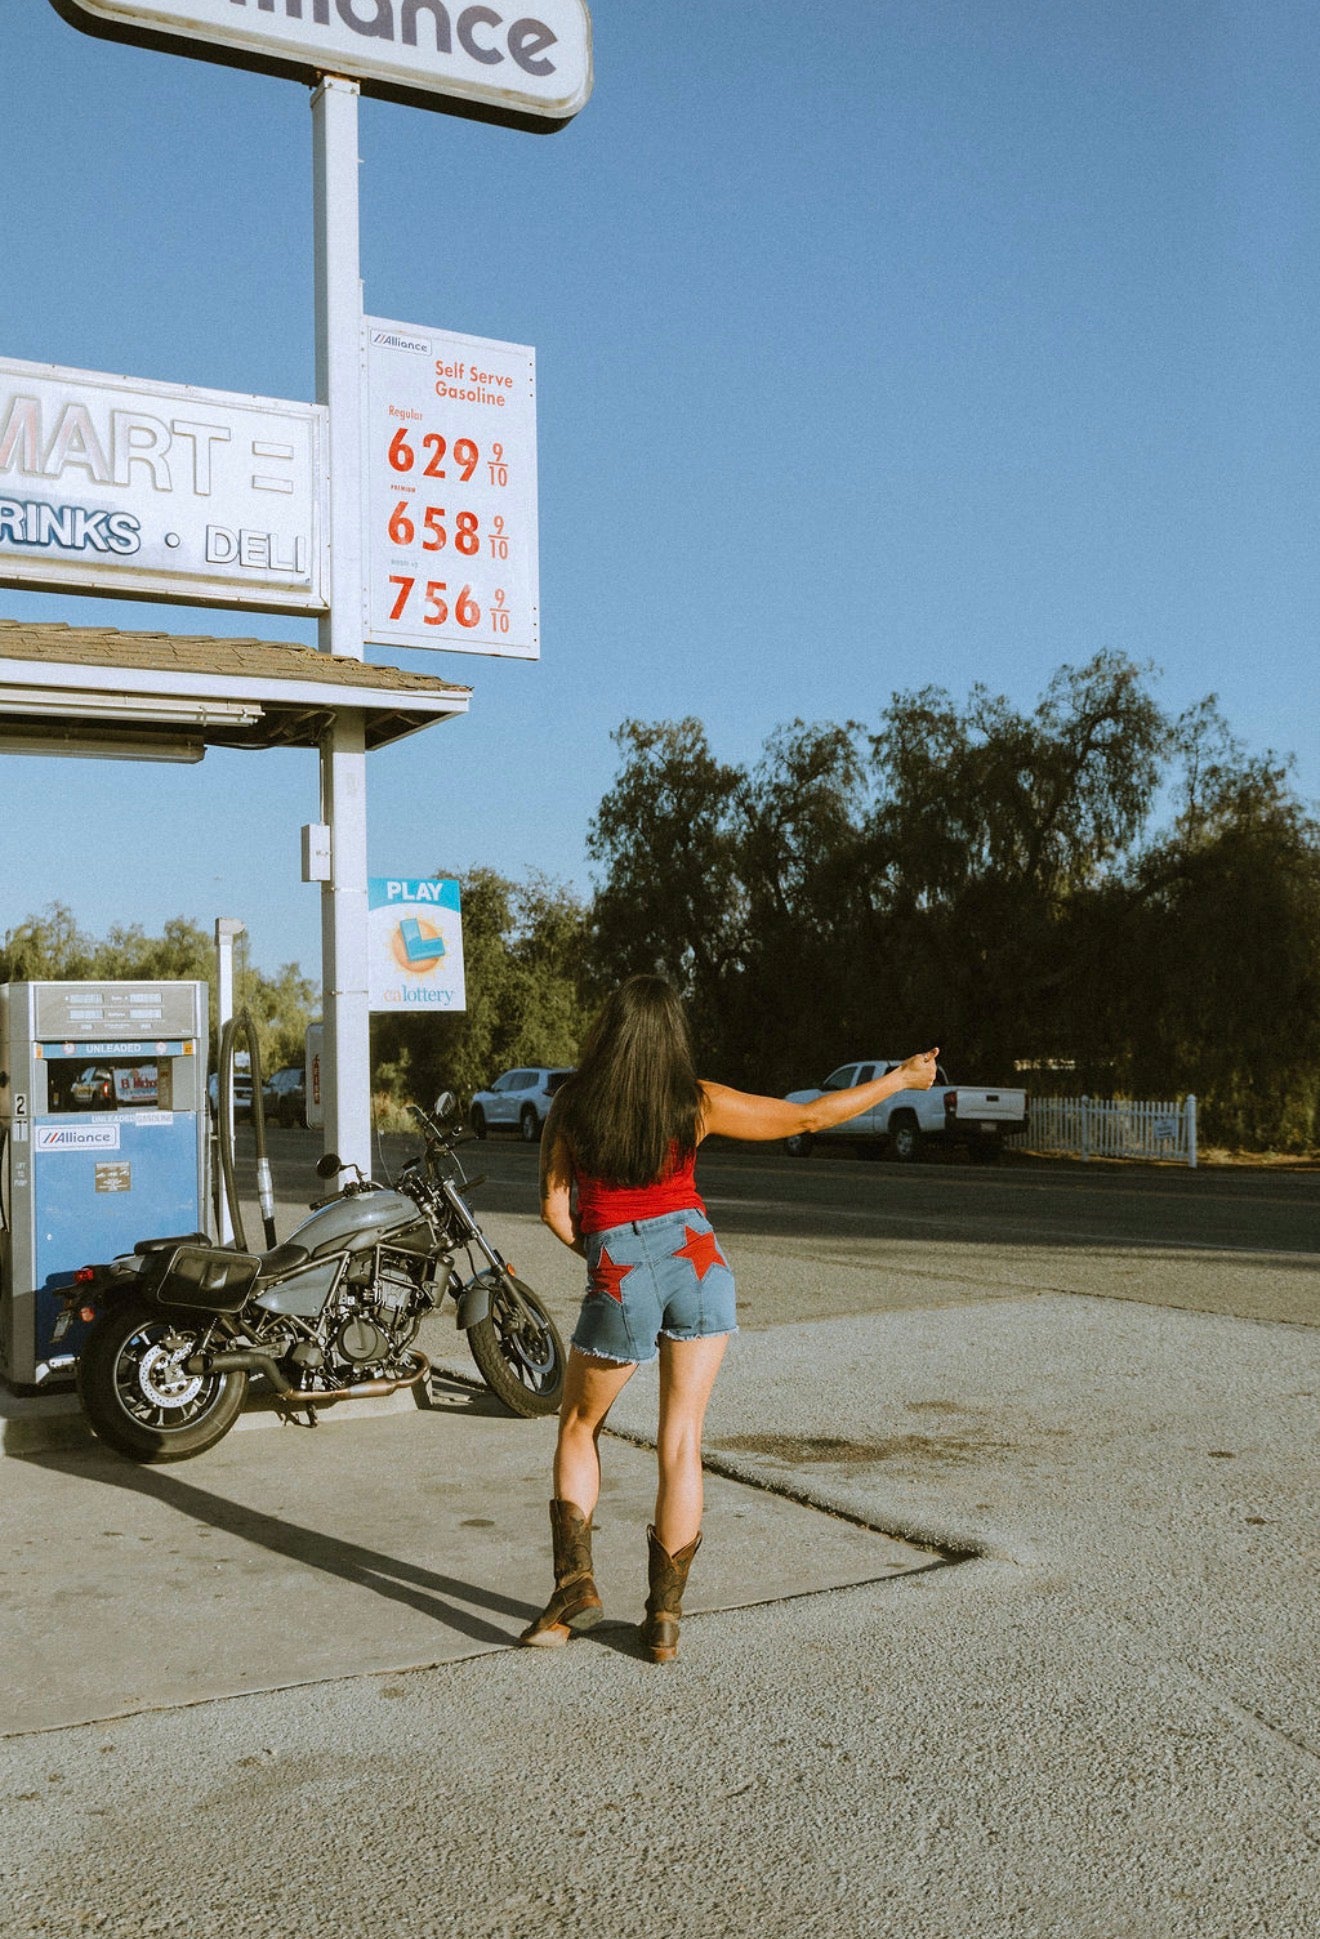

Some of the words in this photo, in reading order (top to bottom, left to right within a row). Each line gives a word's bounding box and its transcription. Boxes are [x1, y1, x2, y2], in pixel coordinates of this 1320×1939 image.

[435, 360, 464, 379] Self
[470, 367, 513, 388] Serve
[435, 381, 505, 406] Gasoline
[388, 404, 423, 421] Regular
[388, 428, 479, 482] 629
[388, 501, 480, 556] 658
[205, 525, 306, 573] DELI
[389, 575, 481, 628] 756
[387, 881, 443, 901] PLAY
[85, 1043, 141, 1054] UNLEADED
[16, 1095, 25, 1115] 2
[55, 1131, 110, 1143] Alliance
